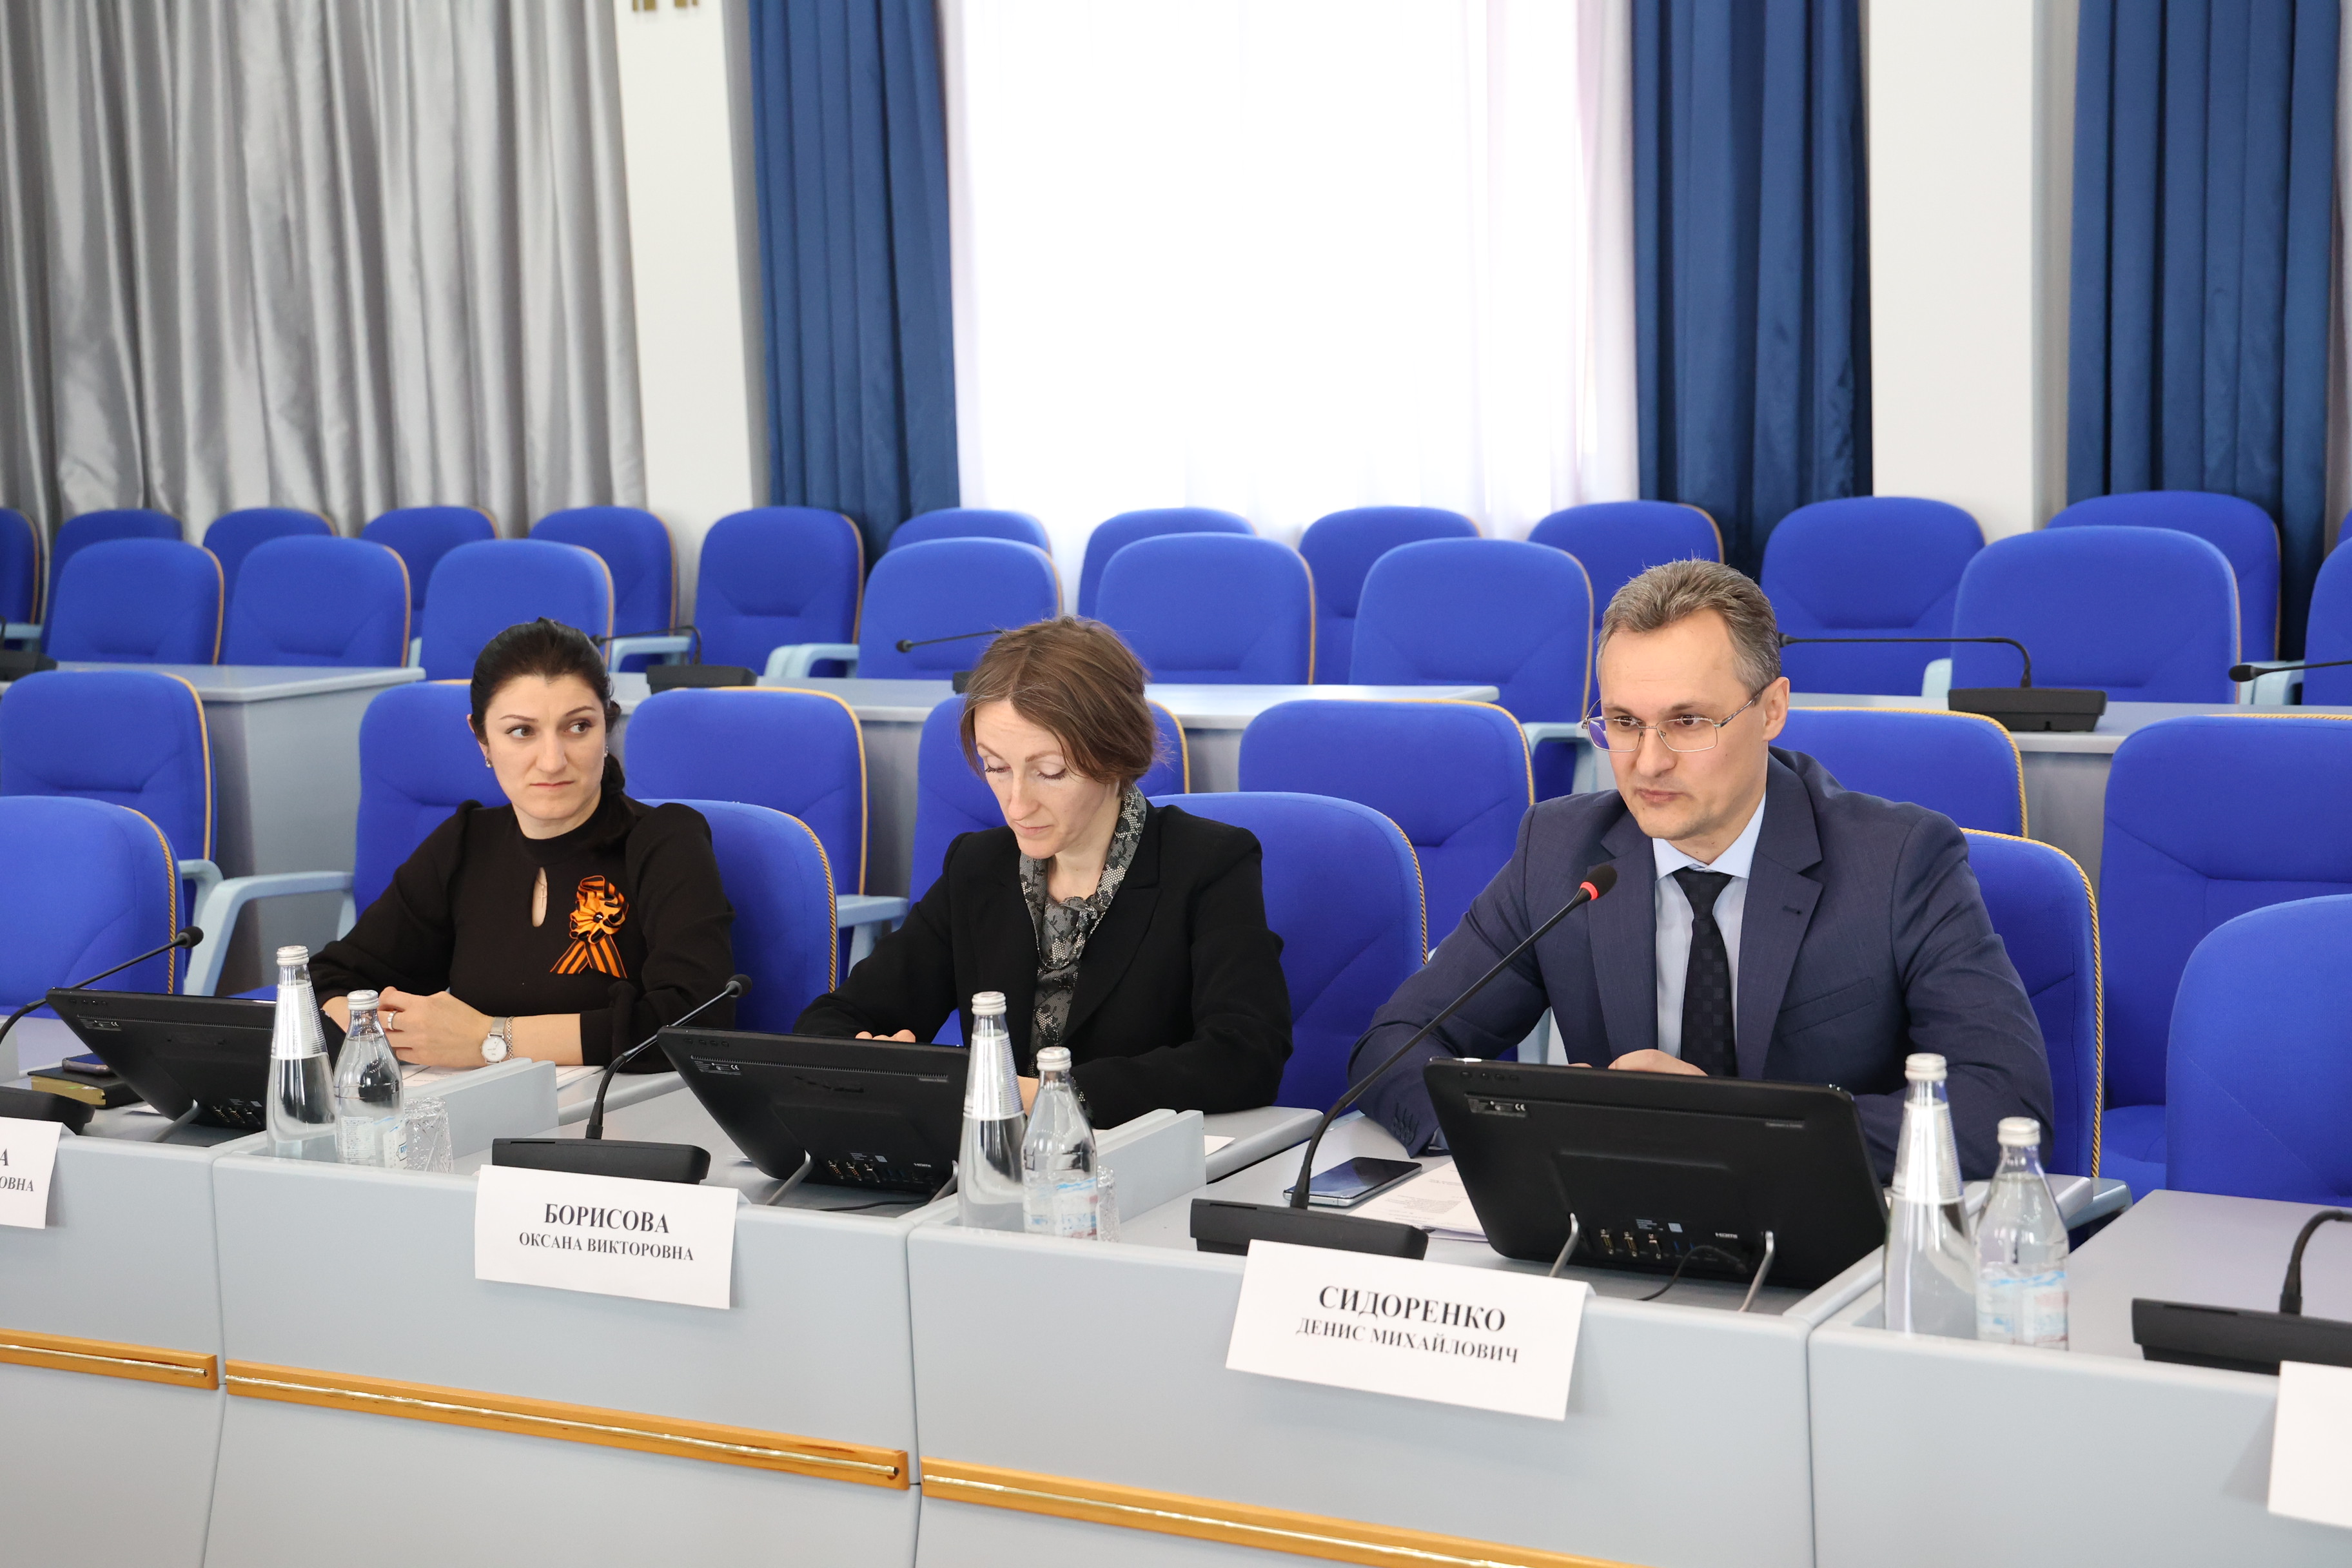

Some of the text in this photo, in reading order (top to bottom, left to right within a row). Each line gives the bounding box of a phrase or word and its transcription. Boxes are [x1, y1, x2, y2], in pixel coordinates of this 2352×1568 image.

[544, 1202, 670, 1234] БОРИСОВА
[519, 1232, 694, 1261] ОКСАНА ВИКТОРОВНА
[1318, 1285, 1507, 1333] СИДОРЕНКО
[1296, 1317, 1520, 1364] ДЕНИС МИХАЙЛОВИЧ
